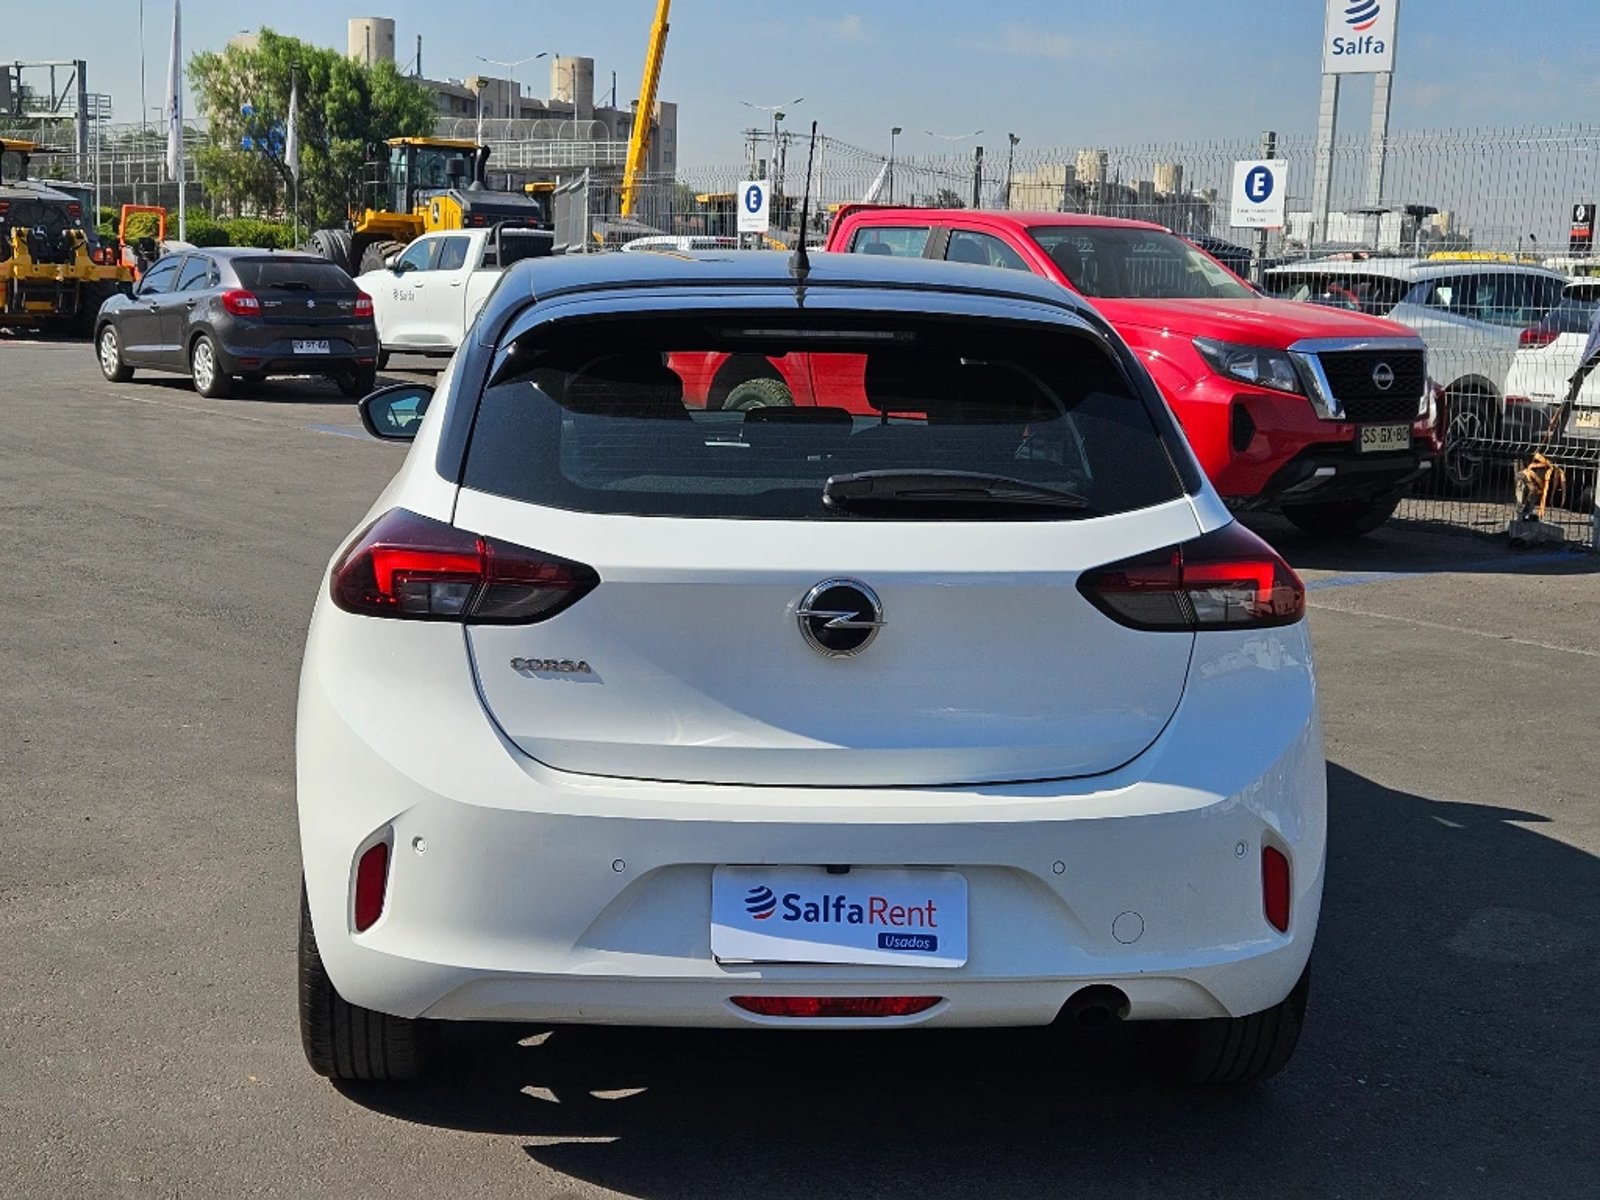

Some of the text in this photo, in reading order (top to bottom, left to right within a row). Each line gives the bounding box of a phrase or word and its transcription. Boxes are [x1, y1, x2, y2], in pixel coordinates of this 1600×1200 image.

[1332, 35, 1385, 55] Salfa
[1252, 172, 1266, 197] E
[749, 190, 758, 209] E
[510, 657, 591, 673] CORSA
[782, 893, 938, 928] SalfaRent
[885, 934, 930, 949] Usados
